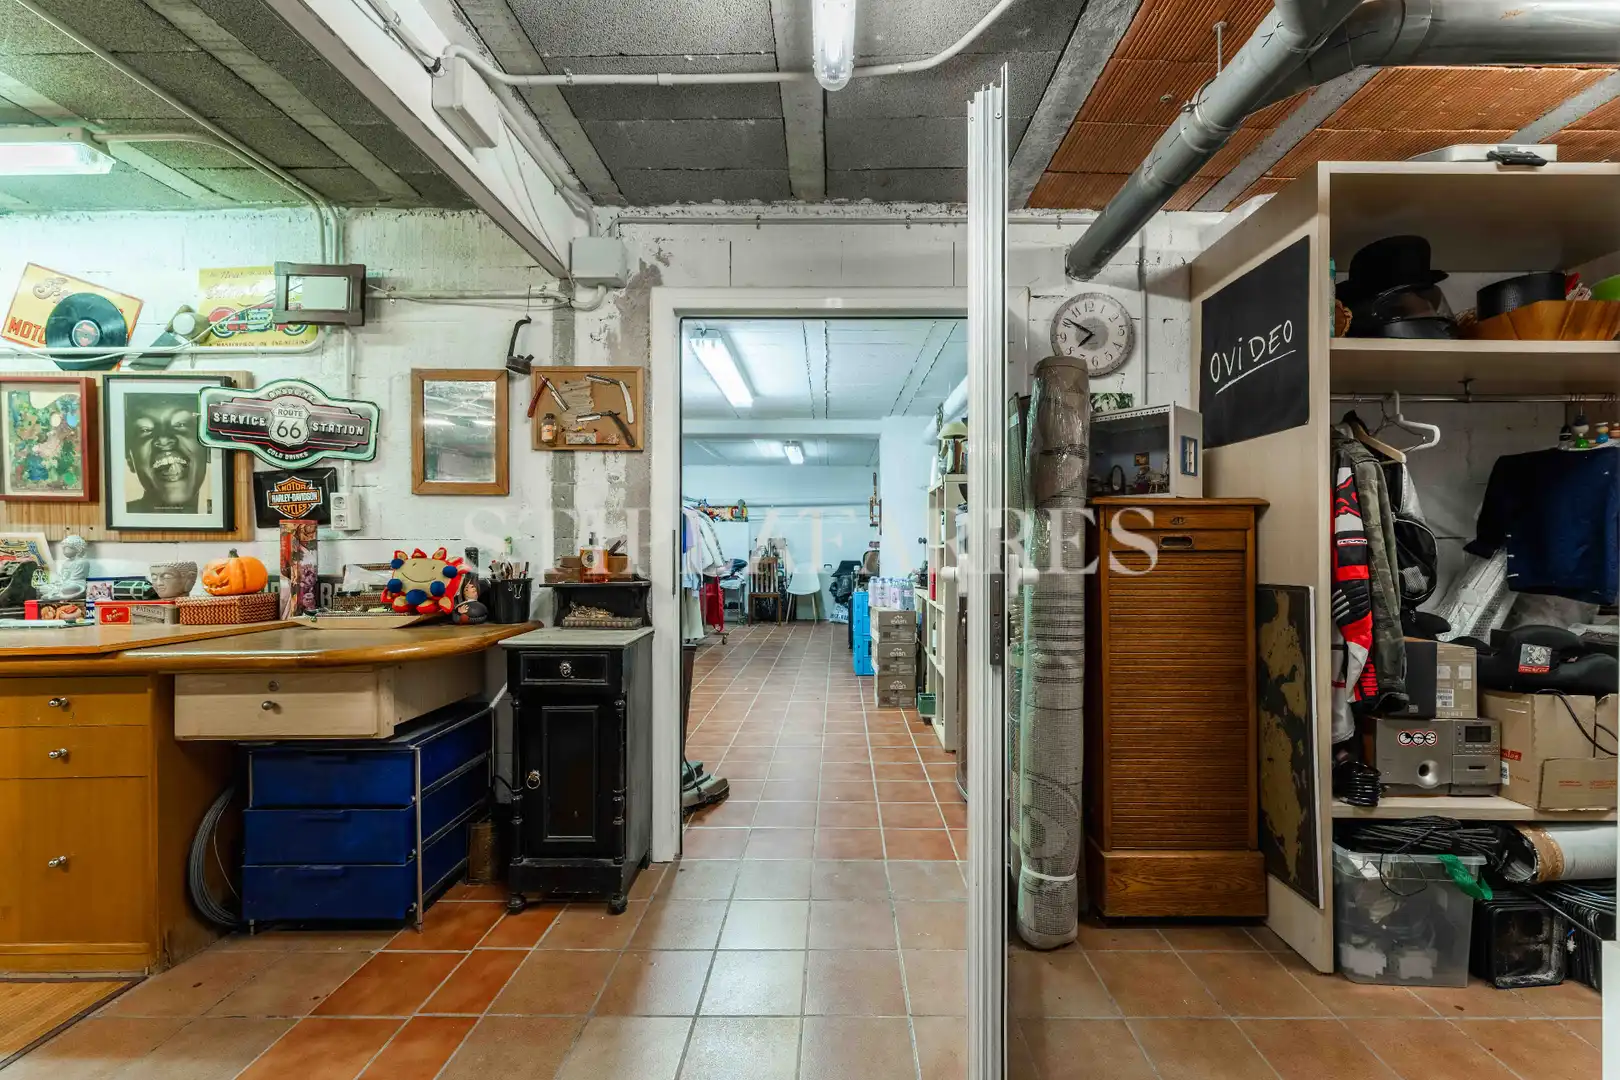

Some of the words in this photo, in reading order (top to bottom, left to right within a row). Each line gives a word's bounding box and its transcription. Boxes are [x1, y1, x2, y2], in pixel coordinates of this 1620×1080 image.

[1084, 301, 1095, 312] 12
[1091, 355, 1099, 367] 6
[277, 408, 303, 417] ROUTE
[212, 411, 267, 427] SERVICE
[276, 420, 302, 438] 66
[311, 421, 365, 436] STATION
[266, 448, 283, 459] COLD
[284, 451, 309, 460] DRINKS
[281, 481, 306, 491] MOTOR
[271, 491, 318, 503] HARLEY-DAVIDSON
[283, 504, 307, 514] CYCLES
